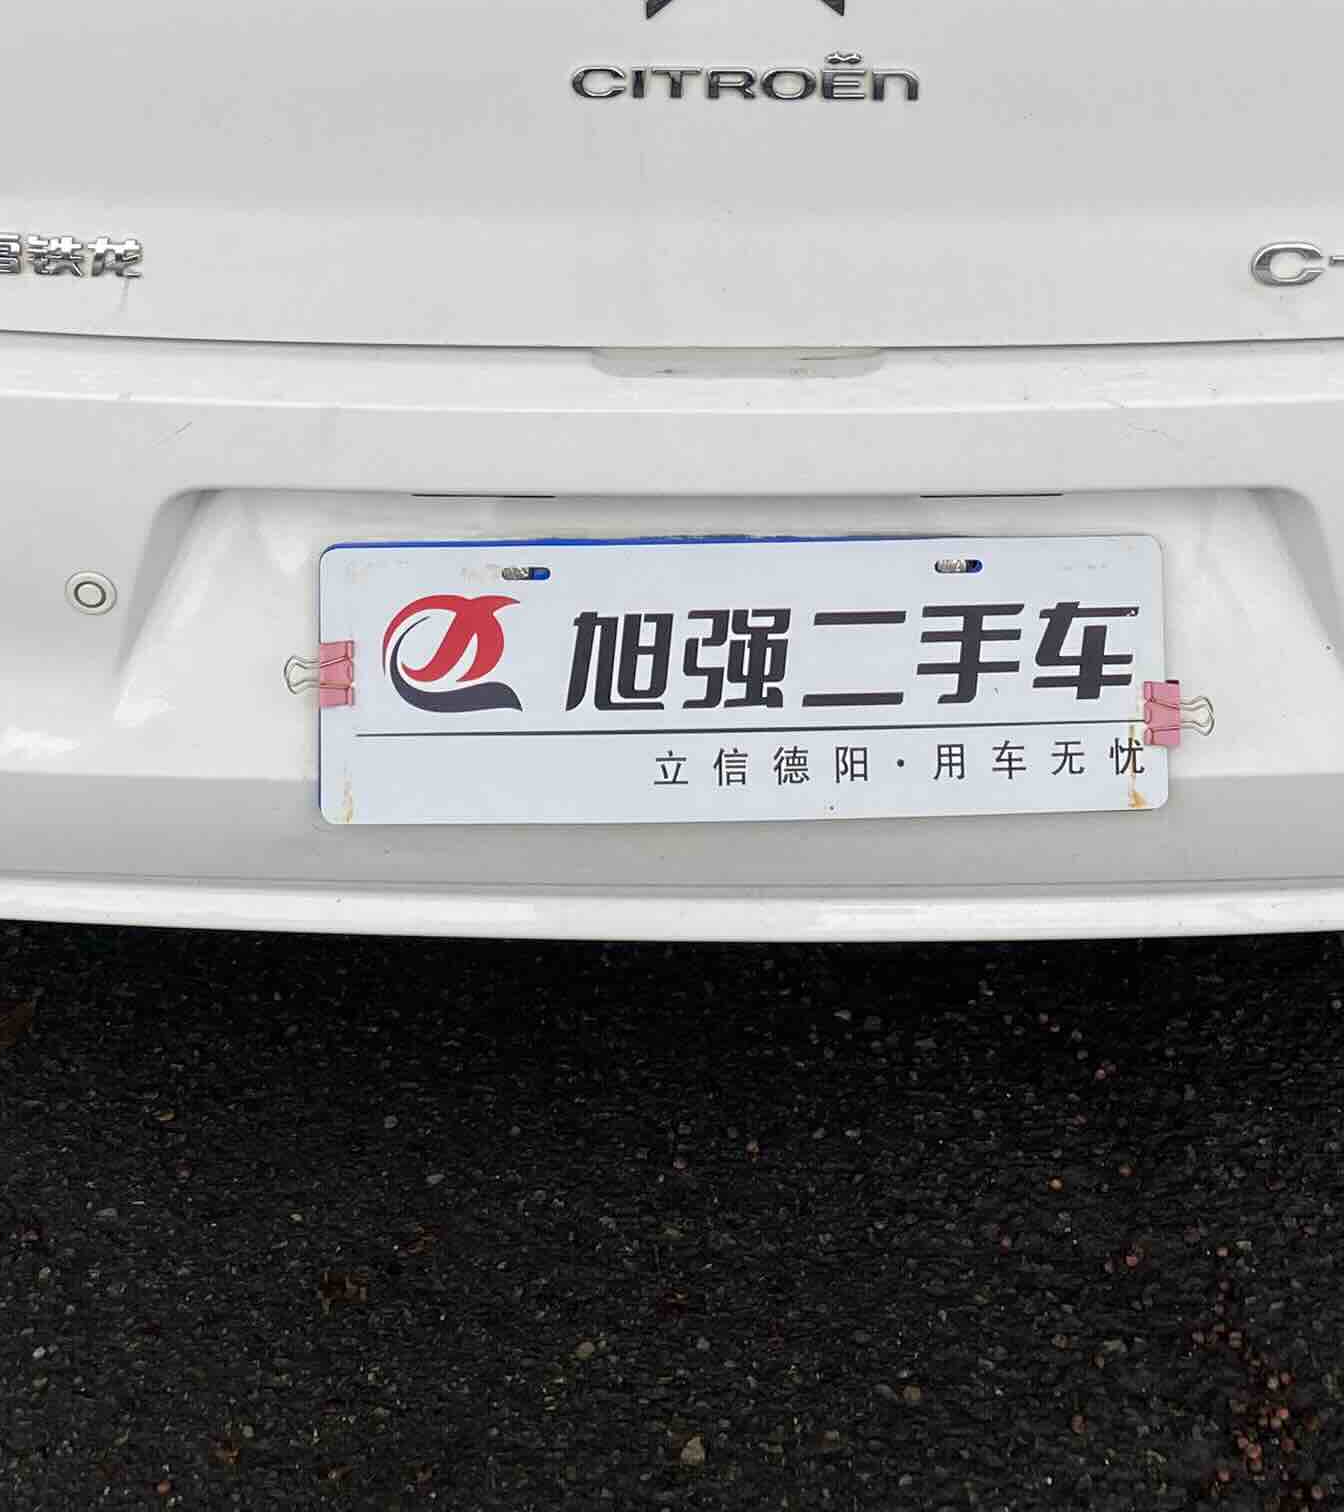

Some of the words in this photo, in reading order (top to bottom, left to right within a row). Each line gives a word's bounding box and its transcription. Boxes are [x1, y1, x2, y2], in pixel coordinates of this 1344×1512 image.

[564, 602, 1141, 714] 旭强二手车
[654, 738, 1146, 788] 立信德阳·用车无忧
